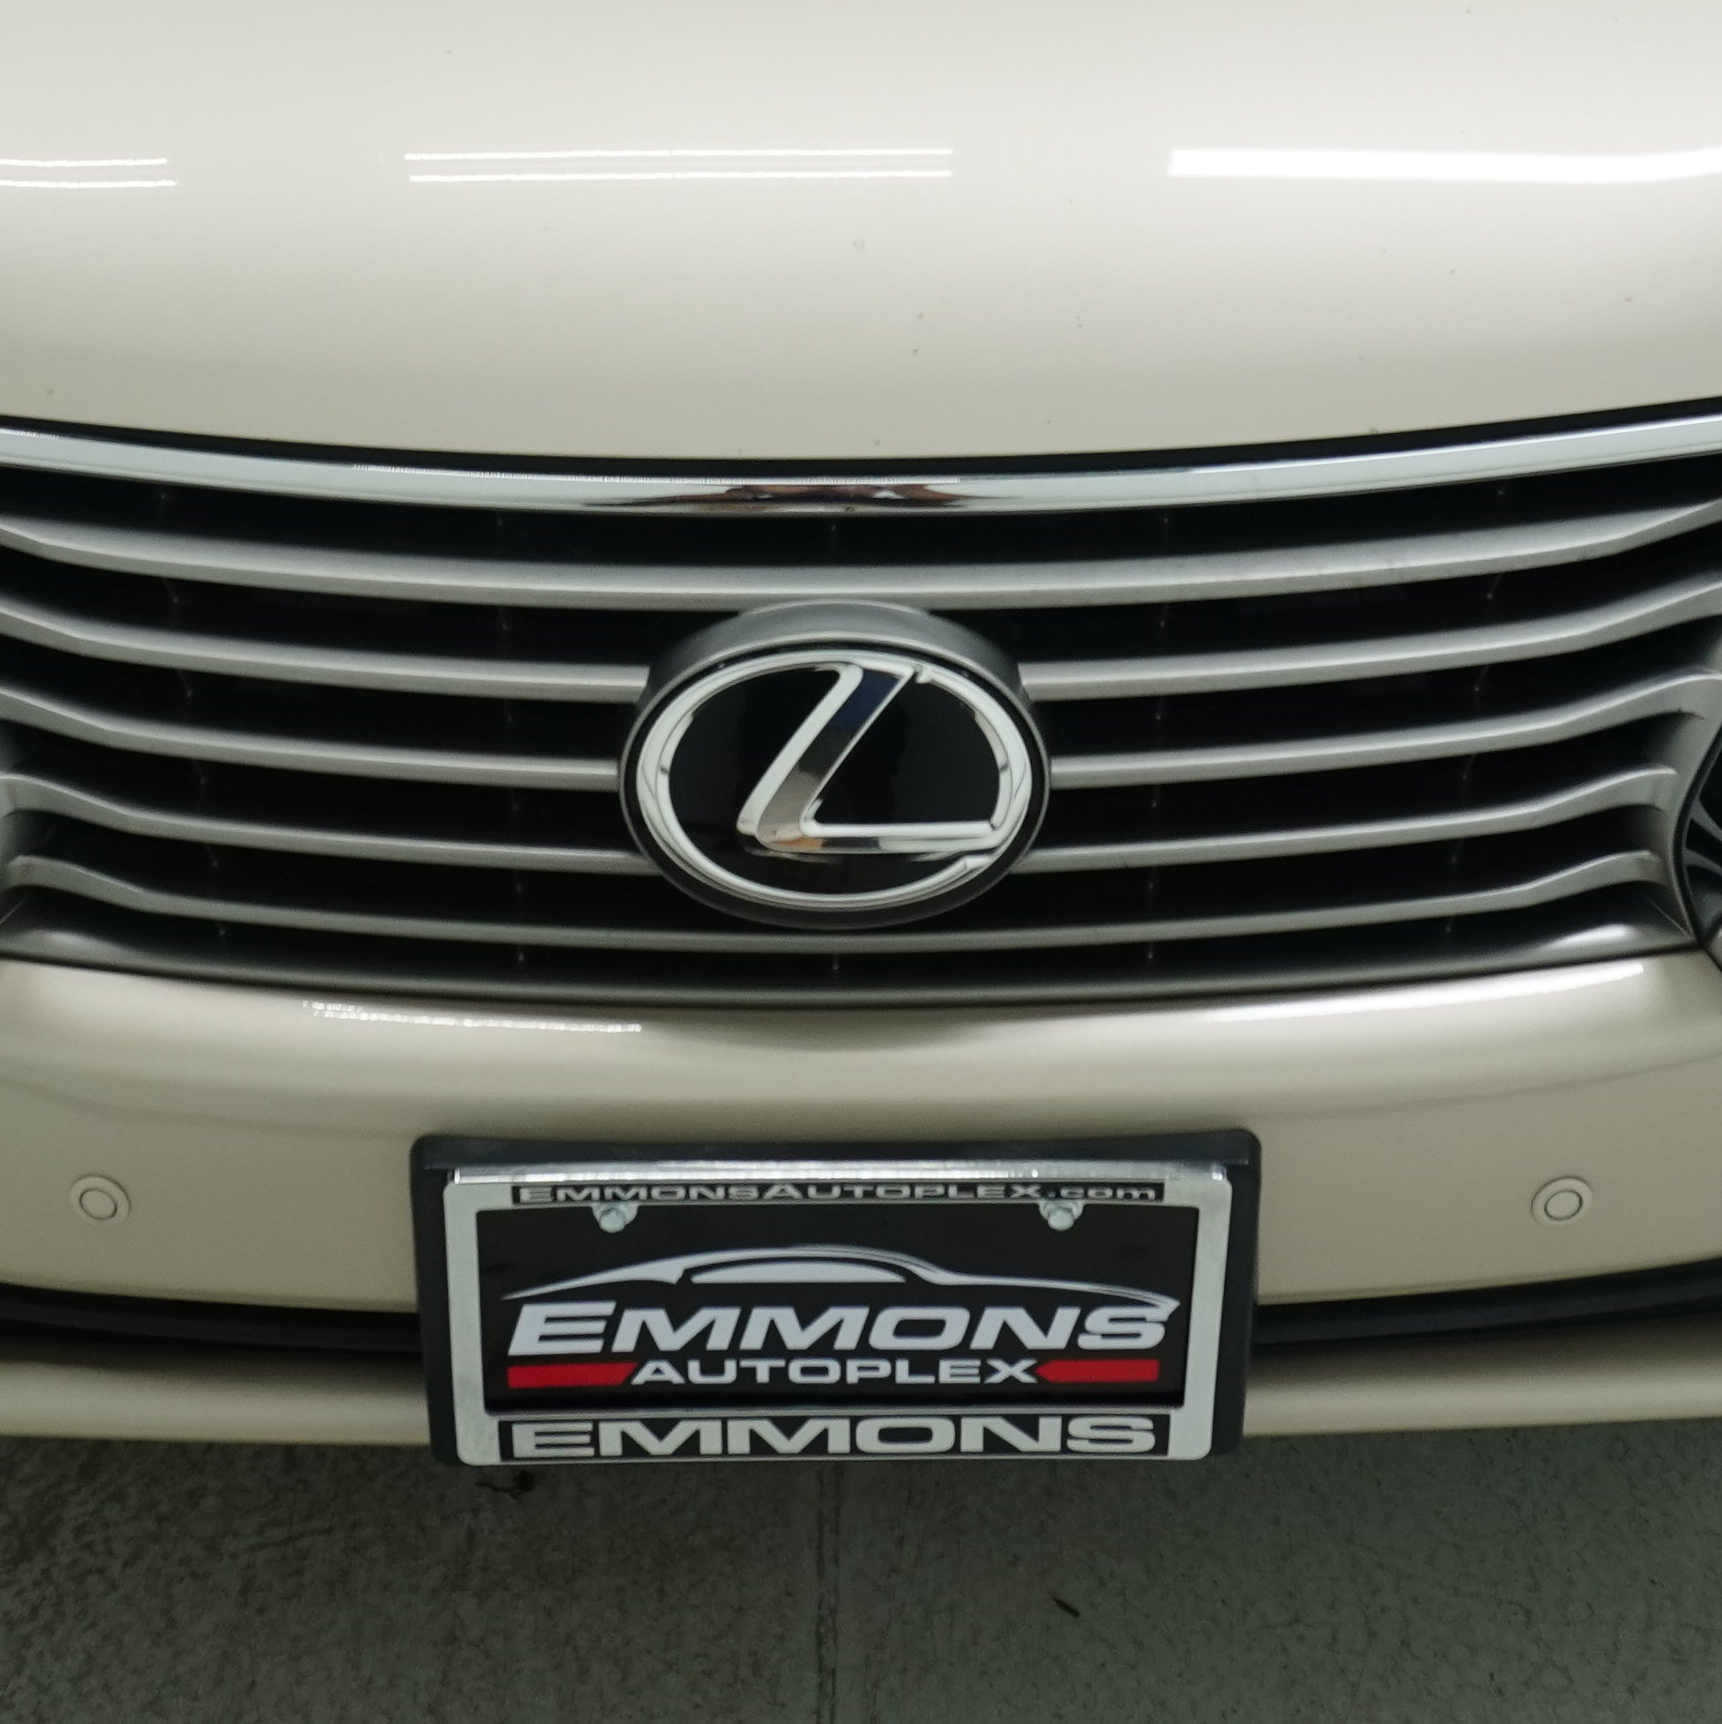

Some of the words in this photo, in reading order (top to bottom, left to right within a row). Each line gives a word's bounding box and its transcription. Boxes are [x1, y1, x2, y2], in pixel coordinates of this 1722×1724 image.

[520, 1183, 1157, 1203] EMMONSAUTOPLEX.com
[507, 1301, 1167, 1356] EMMONS
[631, 1360, 1038, 1385] AUTOPLEX
[511, 1416, 1156, 1458] EMMONS
